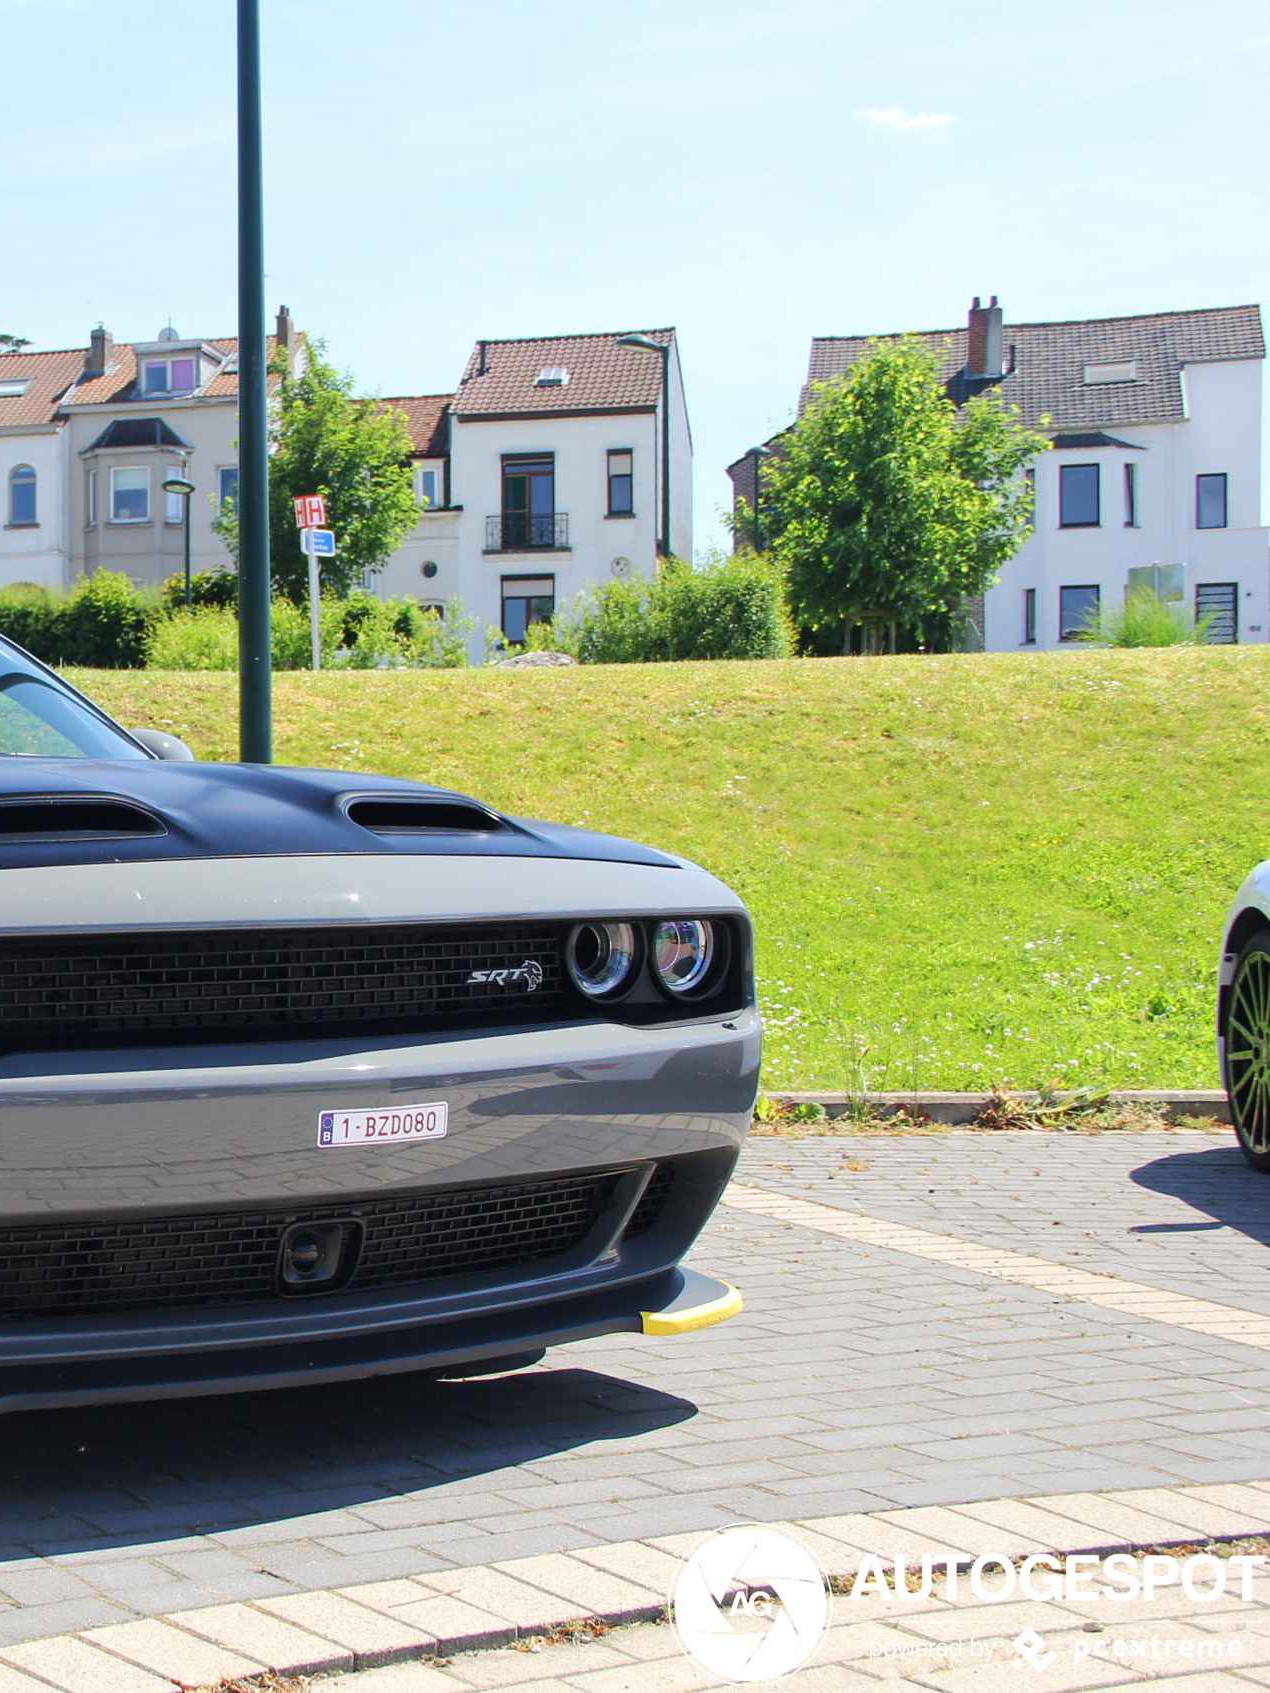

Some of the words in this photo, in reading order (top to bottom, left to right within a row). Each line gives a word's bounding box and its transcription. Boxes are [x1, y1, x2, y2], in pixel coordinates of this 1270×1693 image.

[309, 500, 322, 522] H
[467, 968, 527, 985] SRT
[342, 1111, 436, 1138] 1-BZD080
[323, 1131, 332, 1142] B
